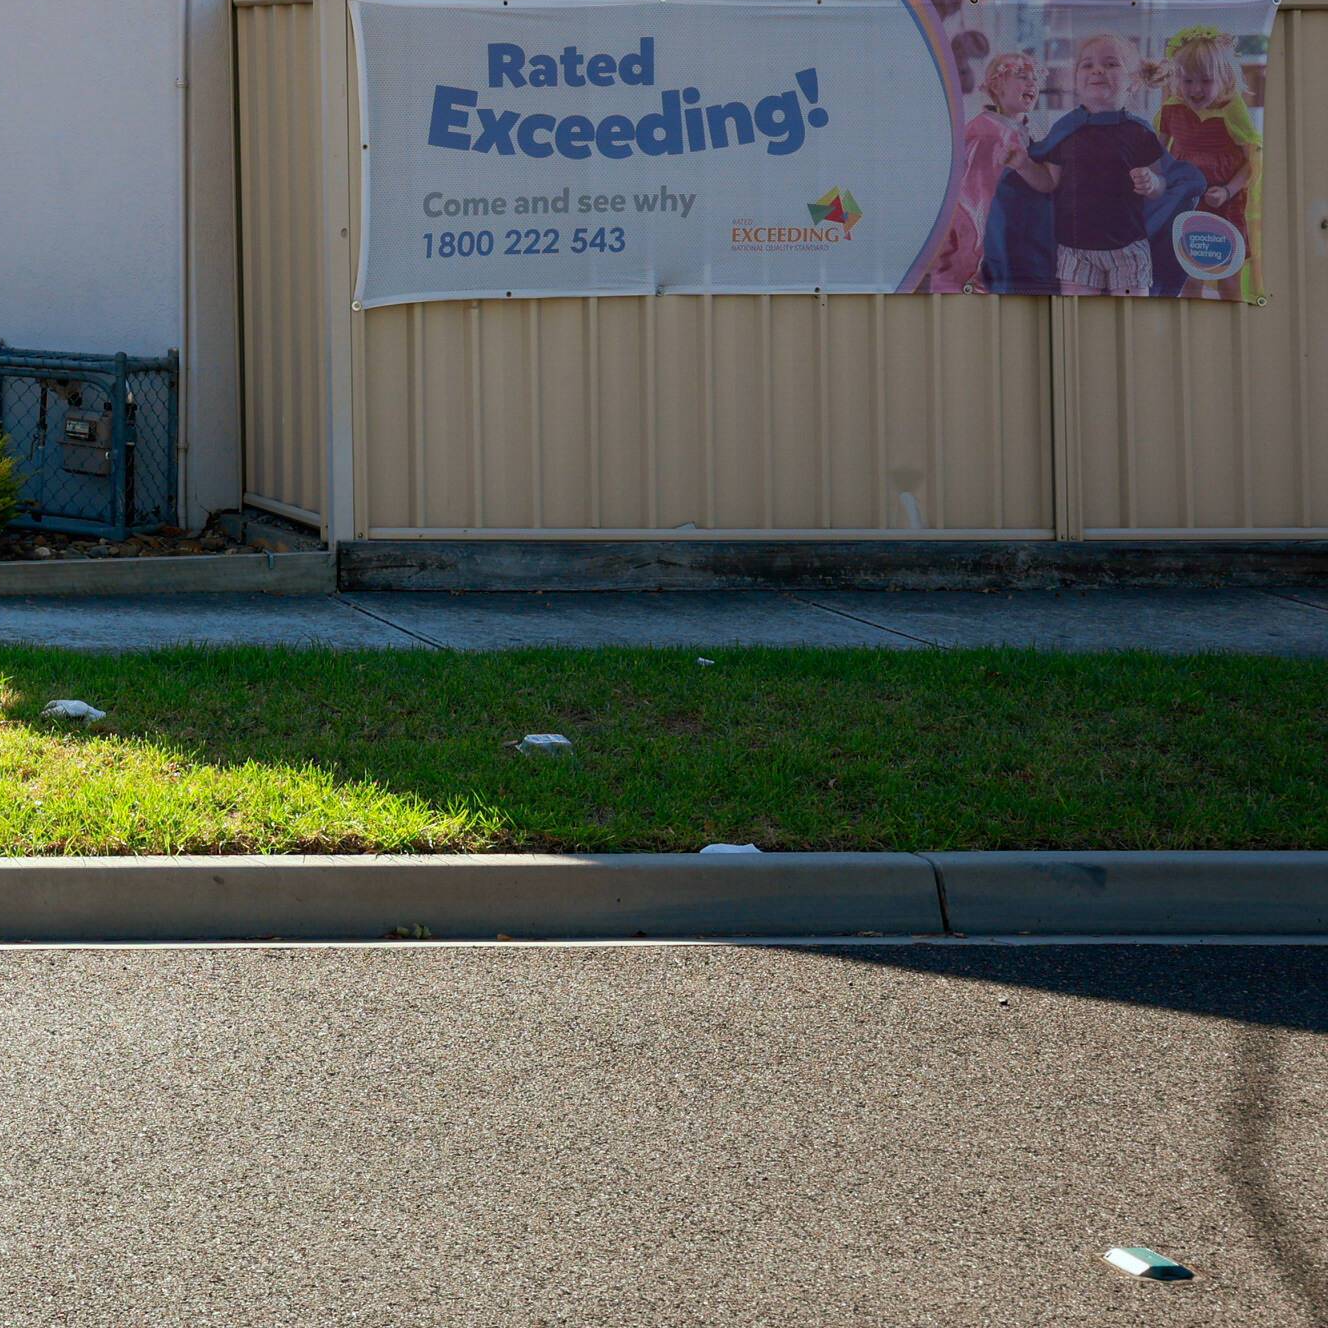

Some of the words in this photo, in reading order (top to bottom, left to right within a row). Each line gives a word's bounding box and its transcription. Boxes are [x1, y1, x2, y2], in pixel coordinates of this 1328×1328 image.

[487, 36, 655, 88] Rated
[427, 67, 829, 159] Exceeding!
[422, 191, 508, 219] Come
[513, 187, 571, 216] and
[577, 193, 626, 214] see
[633, 186, 697, 218] why
[422, 230, 494, 259] 1800
[504, 229, 560, 255] 222
[570, 228, 627, 254] 543
[731, 227, 840, 243] EXCEEDING
